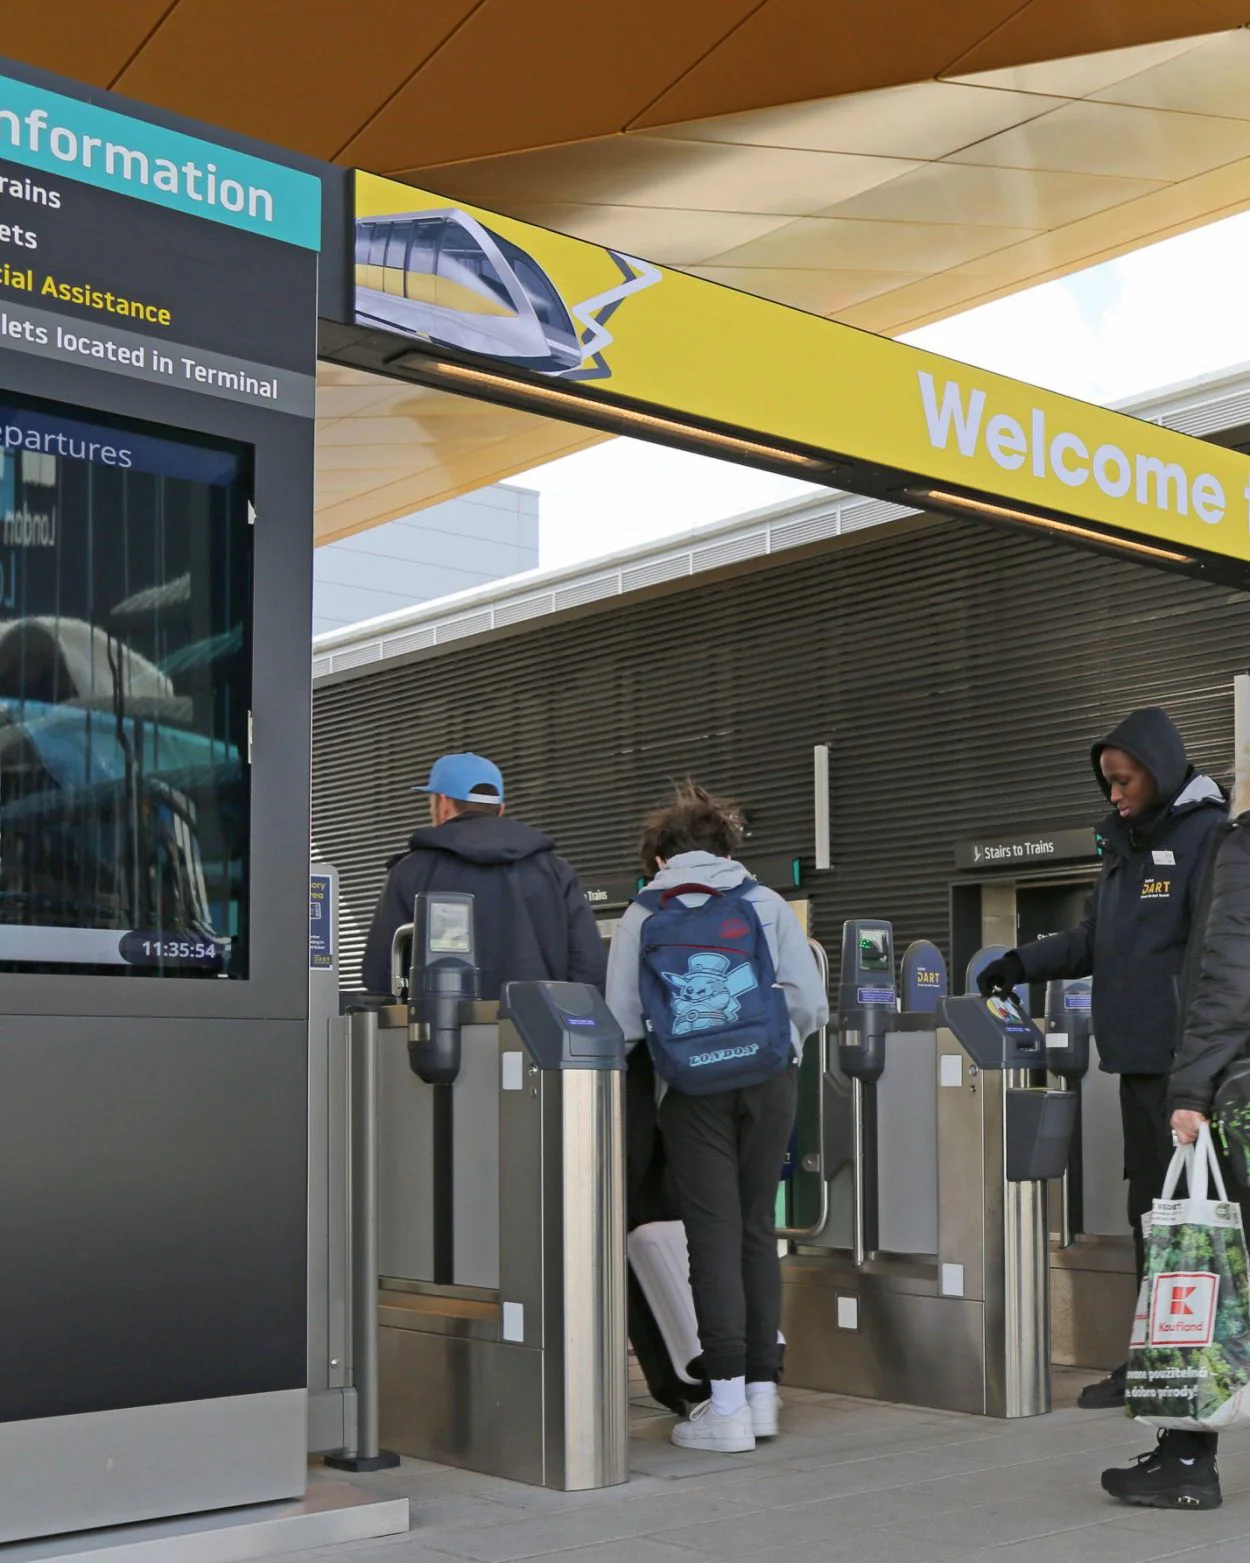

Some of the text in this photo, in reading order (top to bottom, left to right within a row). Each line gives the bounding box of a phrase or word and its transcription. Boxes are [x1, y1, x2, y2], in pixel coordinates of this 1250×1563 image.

[0, 263, 171, 326] ial Assistance
[2, 313, 279, 399] lets located in Terminal
[0, 425, 132, 468] partures
[917, 370, 1226, 525] Welcome
[984, 840, 1055, 860] Stairs to Trains
[588, 890, 608, 902] Trains
[1141, 881, 1171, 895] DART
[142, 940, 216, 959] 11:35:54
[917, 971, 941, 983] DART
[1169, 1286, 1197, 1315] K
[1159, 1322, 1204, 1333] Kaufland
